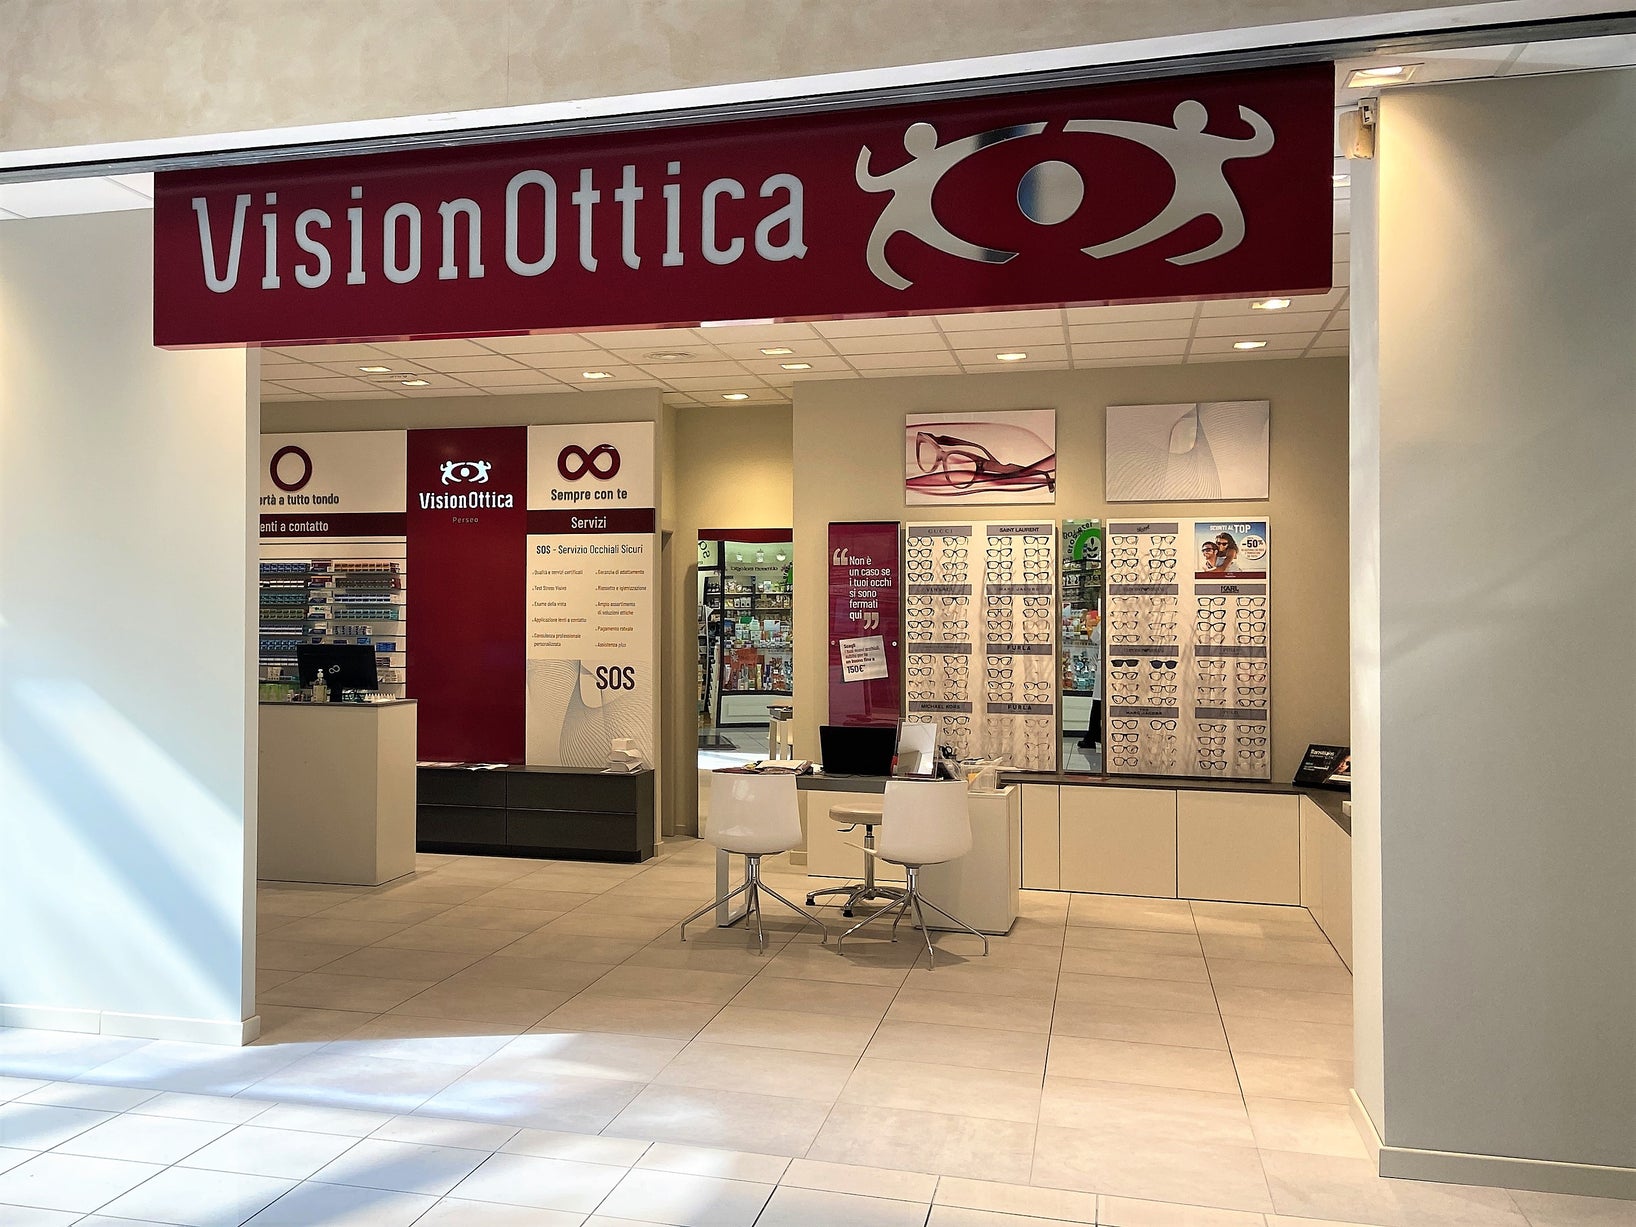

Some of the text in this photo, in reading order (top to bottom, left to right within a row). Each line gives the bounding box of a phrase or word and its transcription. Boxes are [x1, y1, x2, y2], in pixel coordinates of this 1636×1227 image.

[192, 161, 808, 293] VisionOttica
[279, 496, 285, 505] a
[287, 494, 310, 505] tutto
[312, 493, 339, 505] tondo
[419, 491, 514, 510] VisionOttica
[551, 488, 628, 503] Sempre con te
[452, 516, 479, 524] Perseo
[571, 516, 607, 529] Servizi
[280, 523, 286, 532] a
[289, 521, 329, 532] contatto
[1234, 524, 1251, 533] TOP
[536, 545, 551, 555] SOS
[558, 544, 588, 555] Servizio
[589, 544, 619, 555] Occhiali
[621, 543, 643, 554] Sicuri
[866, 555, 872, 565] è
[849, 568, 891, 576] un caso se
[853, 577, 869, 587] tuoi
[870, 577, 892, 587] occhi
[849, 588, 878, 598] si sono
[849, 599, 878, 609] fermati
[849, 610, 862, 622] qui
[596, 666, 635, 690] SOS
